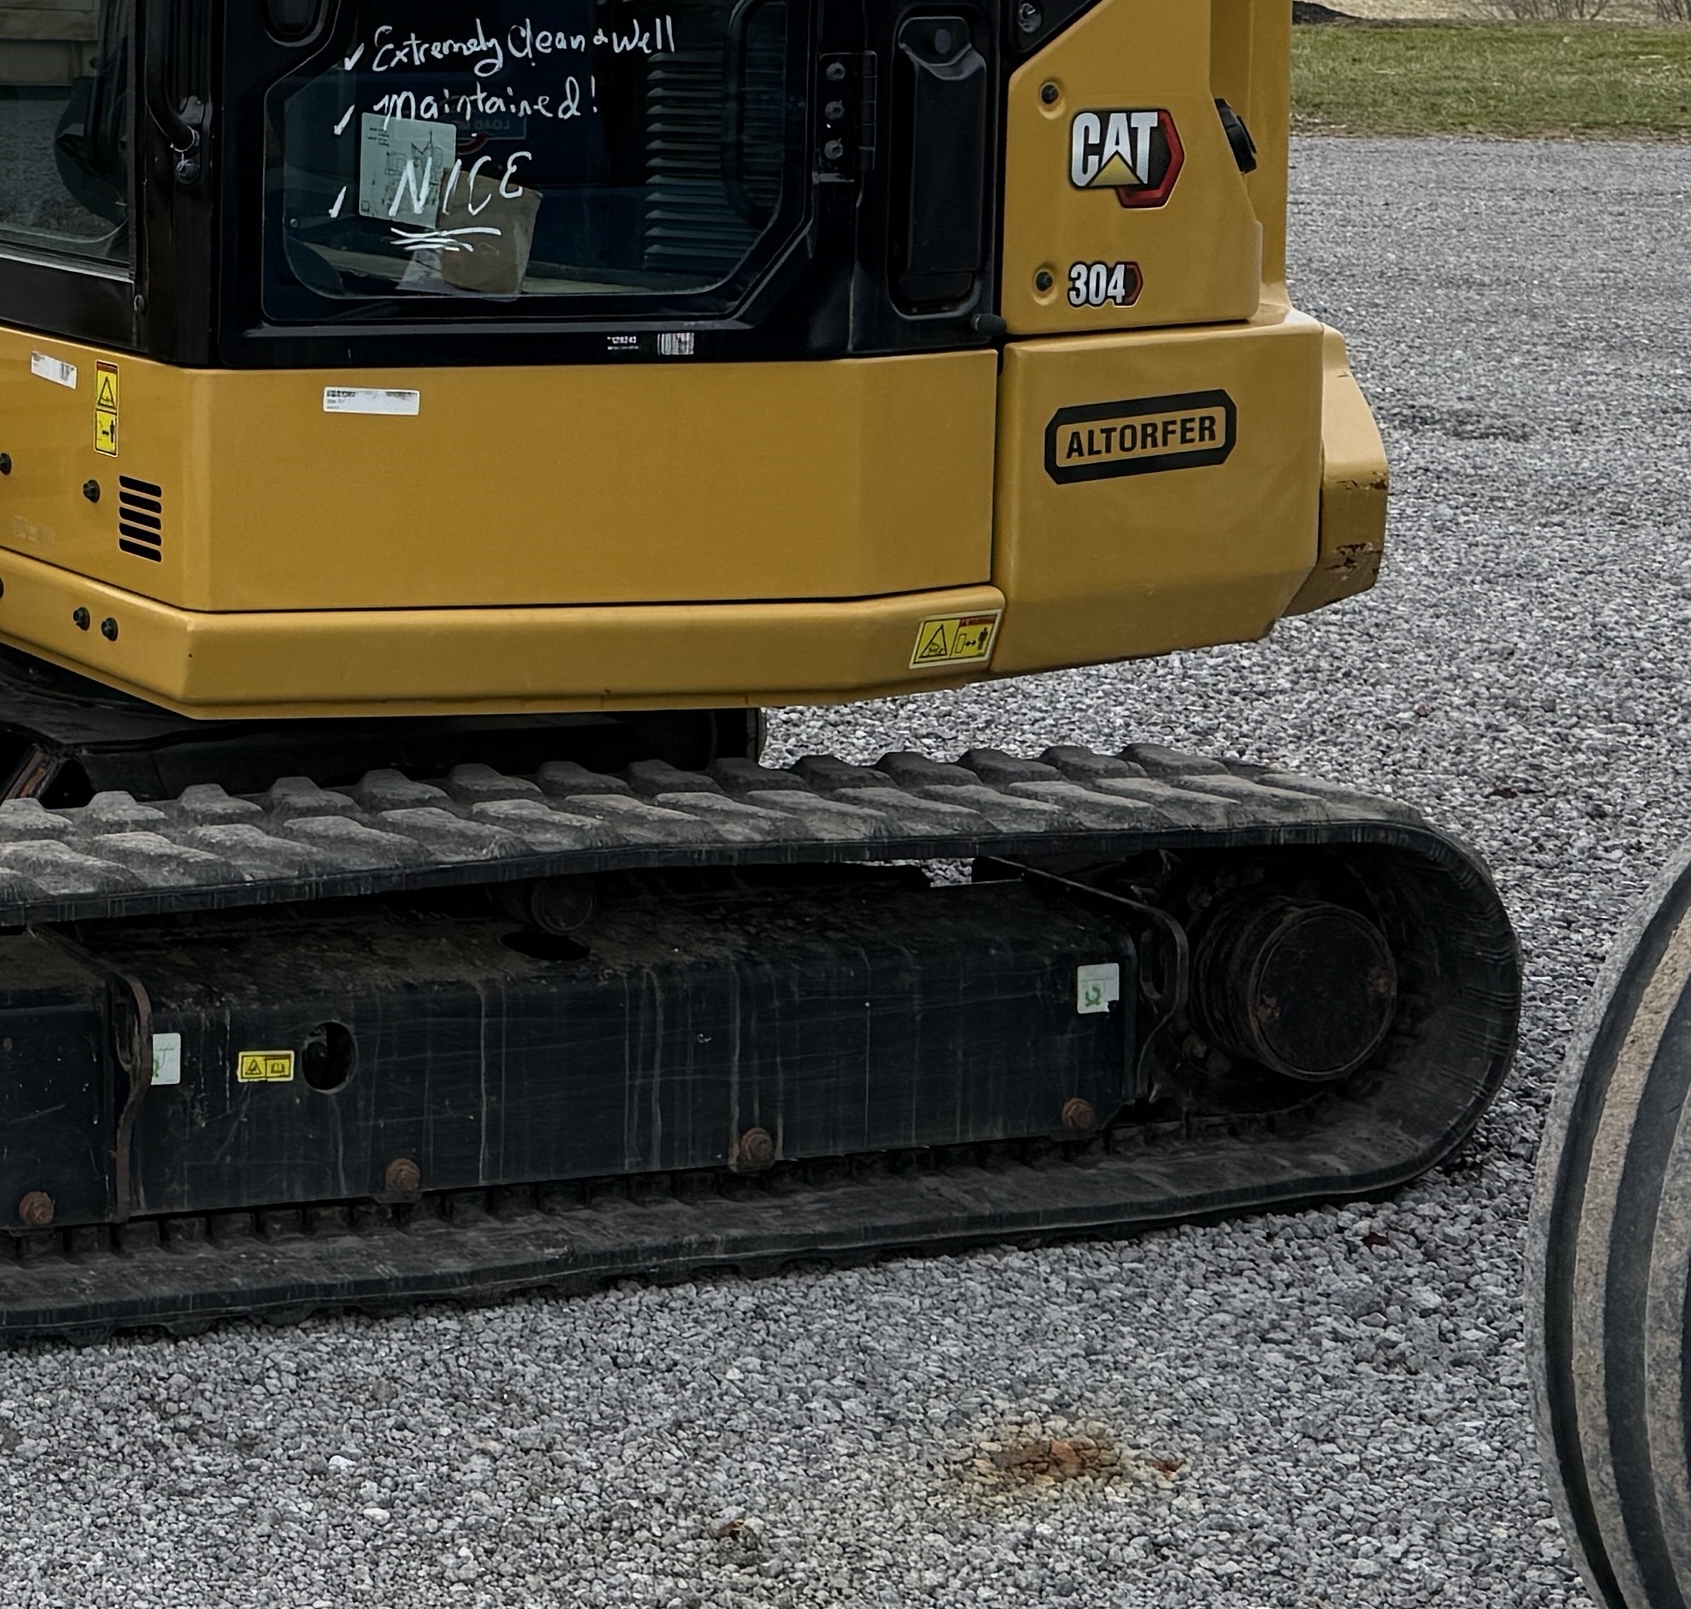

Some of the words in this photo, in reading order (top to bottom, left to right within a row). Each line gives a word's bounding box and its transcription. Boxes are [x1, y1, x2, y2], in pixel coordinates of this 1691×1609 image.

[1071, 111, 1159, 188] CAT
[388, 150, 533, 217] NICE
[1067, 262, 1127, 307] 304
[1065, 415, 1218, 460] ALTORFER
